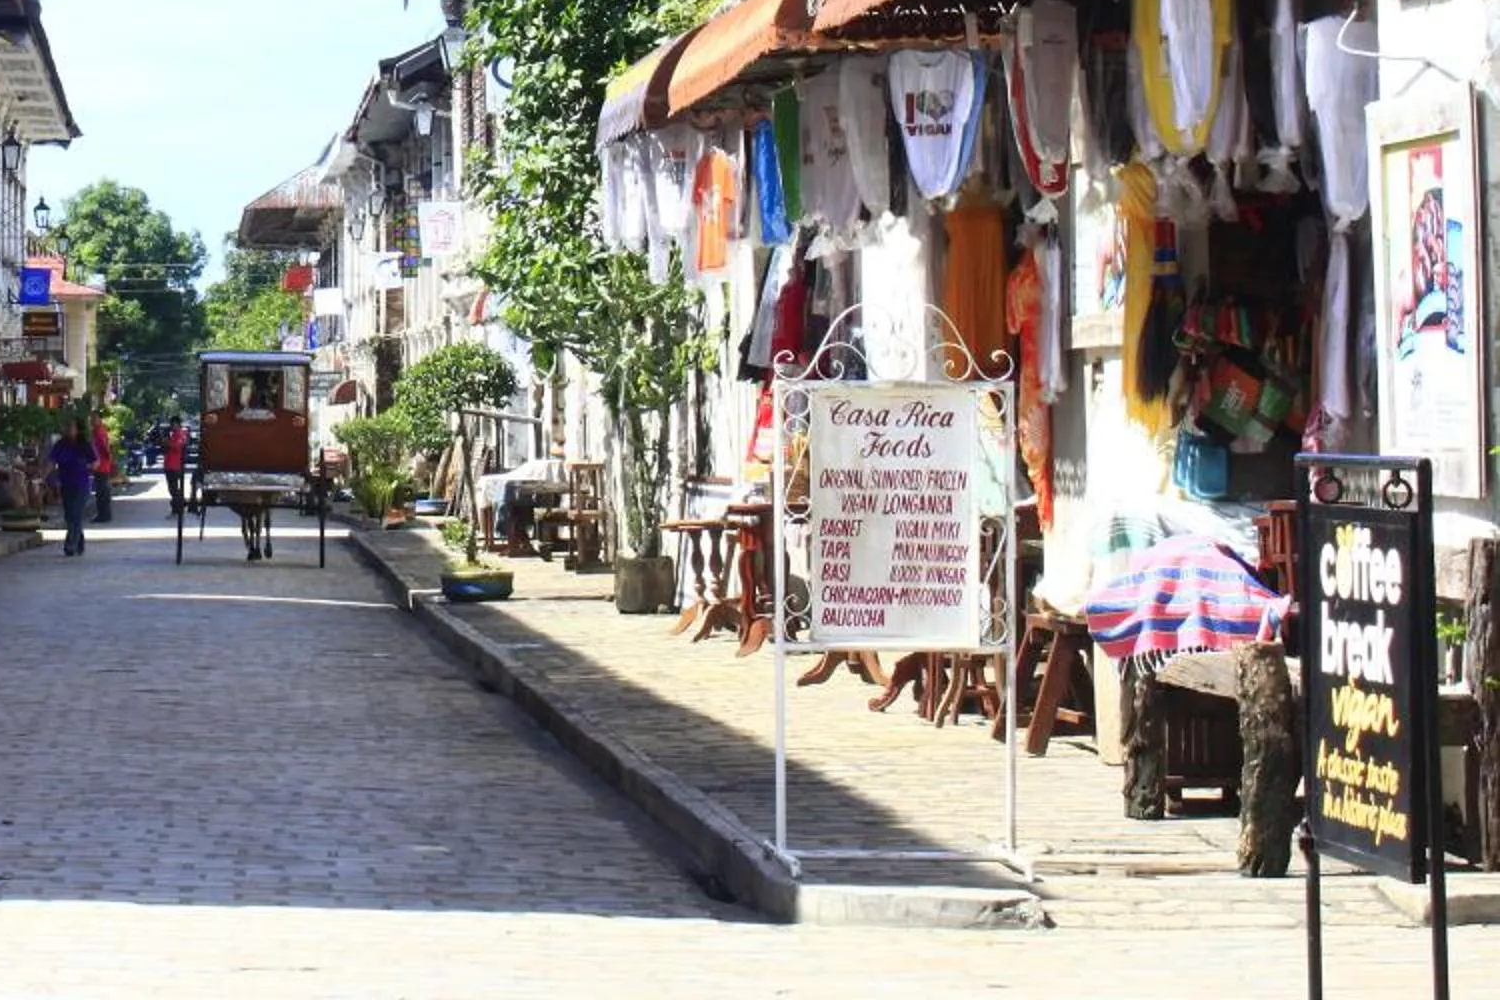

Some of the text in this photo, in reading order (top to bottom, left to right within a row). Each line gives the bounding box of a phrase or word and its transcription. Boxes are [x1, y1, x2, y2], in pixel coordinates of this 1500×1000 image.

[829, 400, 955, 428] Casa Rica
[860, 431, 933, 459] Foods
[819, 519, 863, 537] BAGNET
[820, 540, 851, 560] TAPA
[821, 562, 851, 582] BASI
[1320, 526, 1402, 605] coffee
[1321, 601, 1394, 684] break
[1331, 678, 1399, 752] vigan
